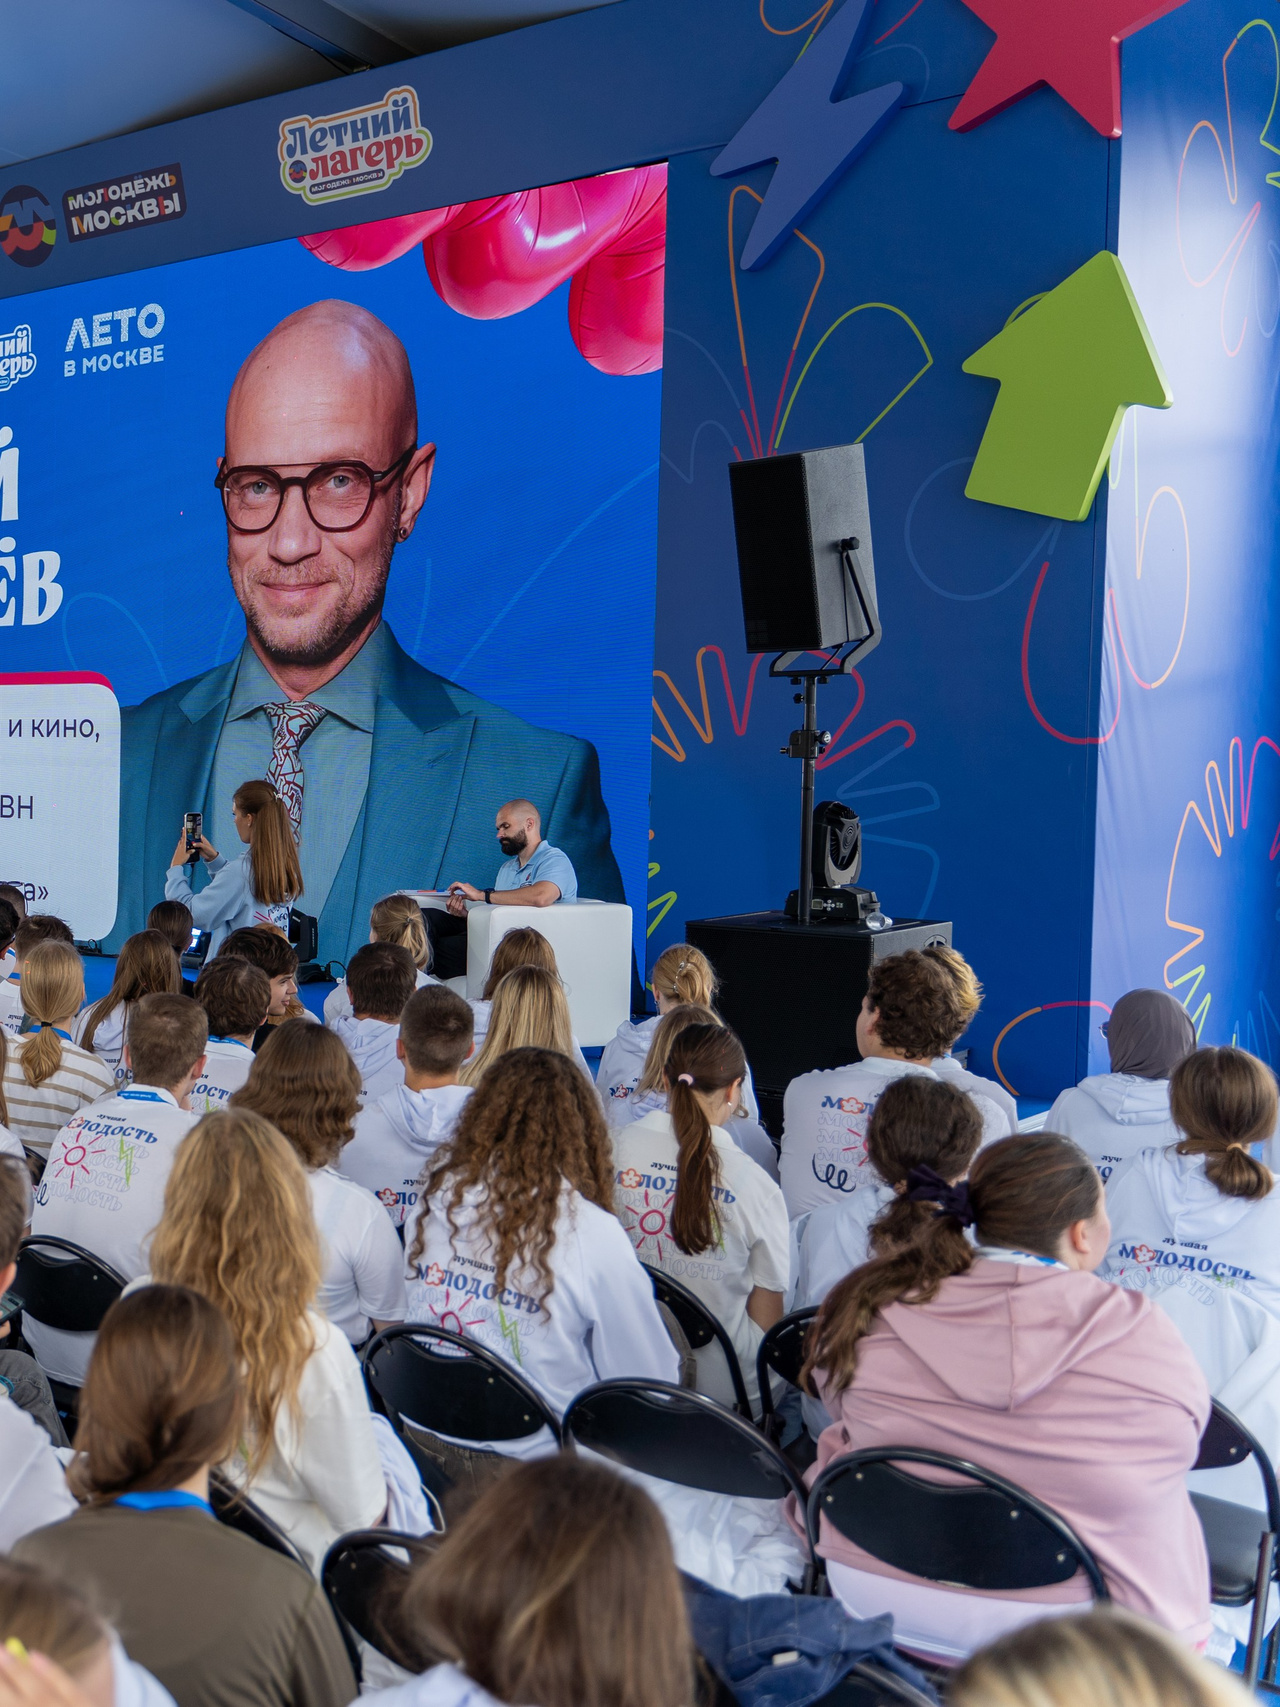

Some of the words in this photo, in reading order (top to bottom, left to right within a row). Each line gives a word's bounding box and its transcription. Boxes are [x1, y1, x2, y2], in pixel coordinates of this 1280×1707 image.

[286, 97, 412, 158] Летний
[309, 134, 424, 180] лагерь
[67, 172, 177, 210] МОЛОДЁЖЬ
[71, 193, 181, 235] МОСКВЫ
[64, 303, 166, 352] ЛЕТО
[63, 359, 76, 378] В
[82, 344, 165, 374] МОСКВЕ
[8, 718, 23, 738] и
[31, 717, 101, 743] кино,
[453, 1254, 496, 1273] лучшая
